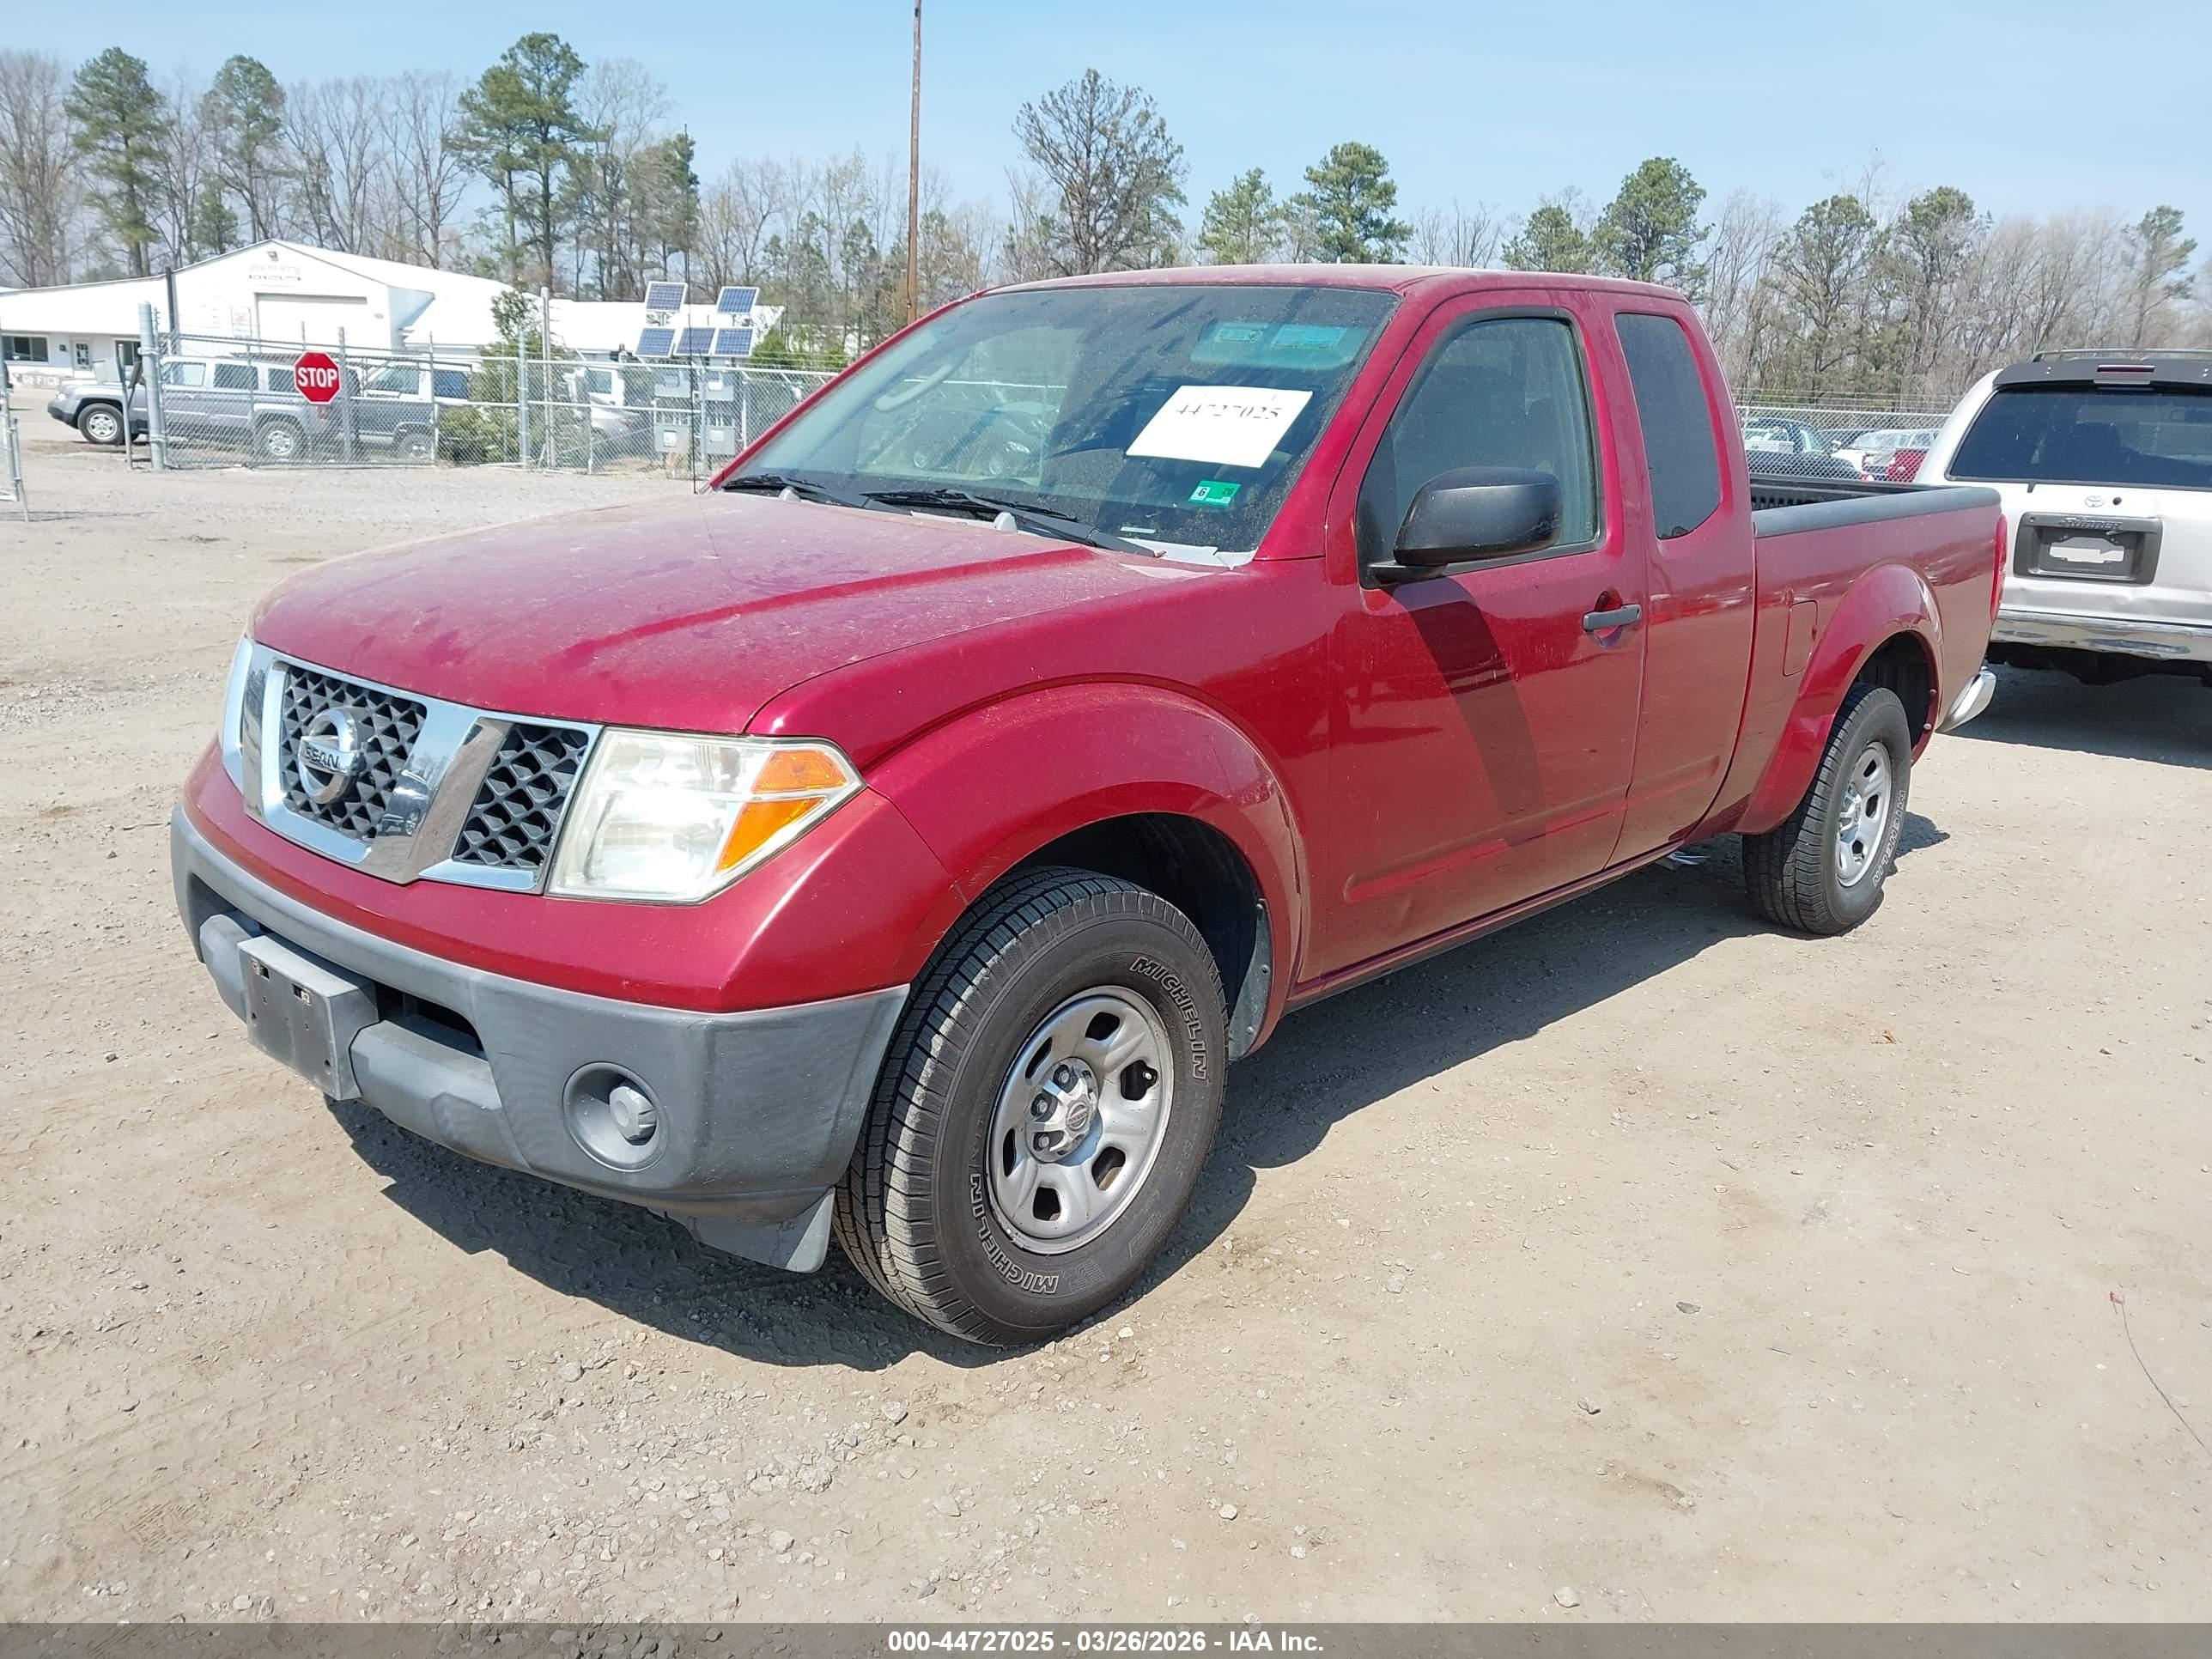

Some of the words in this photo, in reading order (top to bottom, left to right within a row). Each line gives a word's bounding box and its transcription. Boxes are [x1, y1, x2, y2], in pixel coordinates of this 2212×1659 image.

[22, 374, 60, 386] OFFICE
[298, 367, 337, 388] STOP
[1198, 487, 1207, 496] 6
[1221, 487, 1236, 496] 26
[302, 744, 339, 769] SSAN
[1873, 790, 1906, 887] MICHELIN
[1128, 956, 1207, 1080] MICHELIN
[970, 1173, 1060, 1294] MICHELIN
